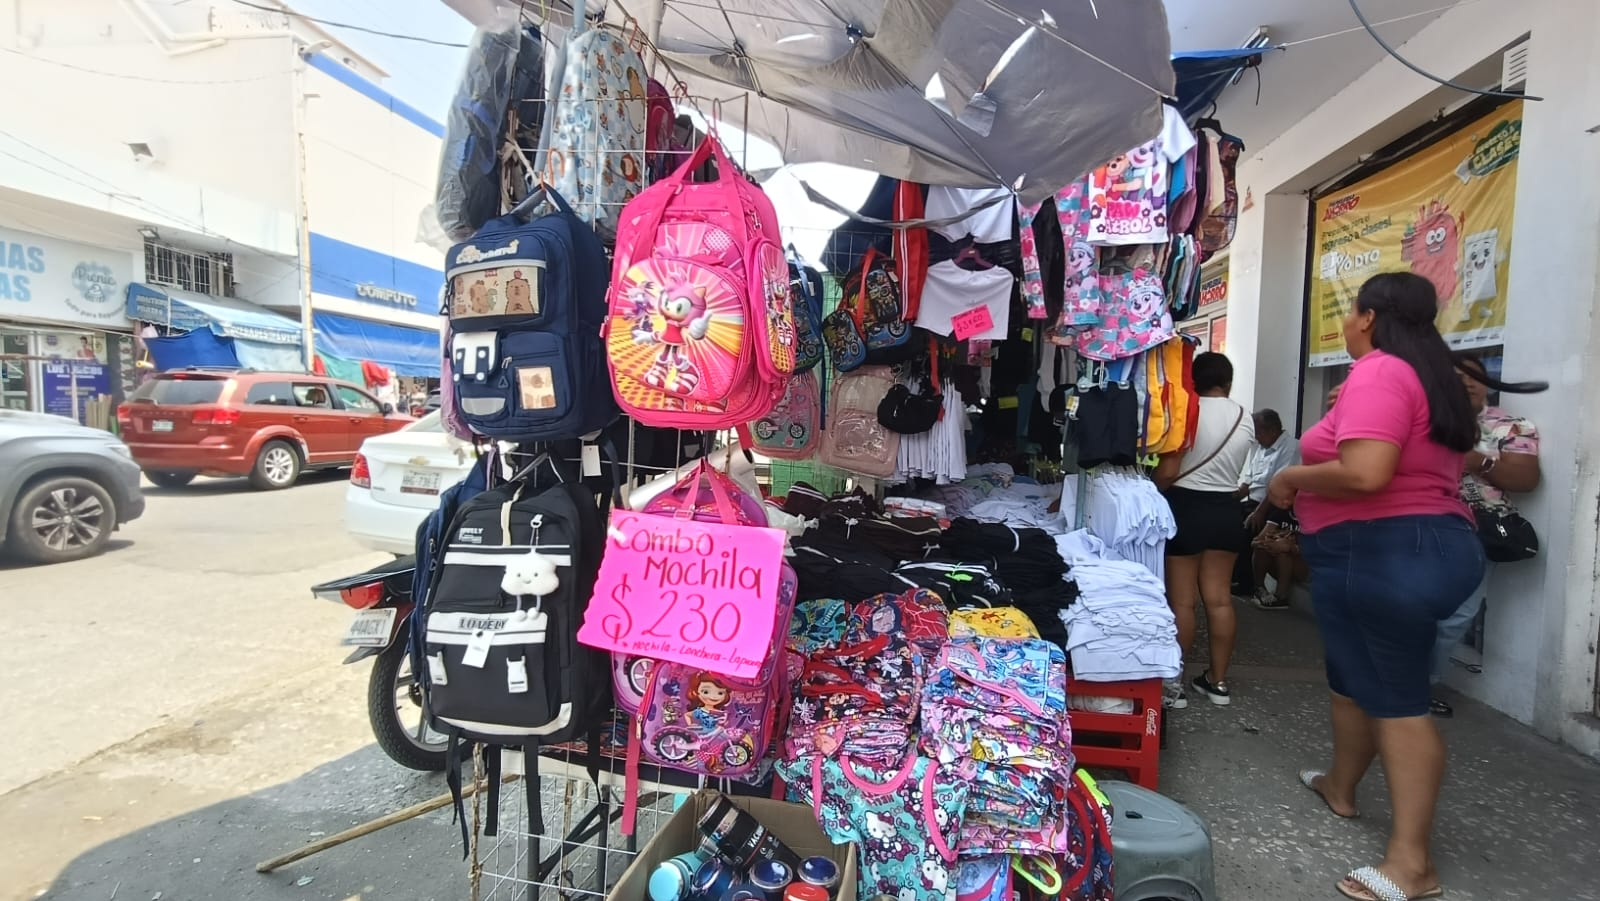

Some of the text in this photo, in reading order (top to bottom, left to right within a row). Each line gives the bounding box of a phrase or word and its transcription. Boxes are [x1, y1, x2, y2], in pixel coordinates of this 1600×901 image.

[1106, 201, 1140, 218] PAW
[612, 517, 714, 557] Combo
[643, 548, 762, 599] Mochila
[459, 617, 508, 631] LOVELY
